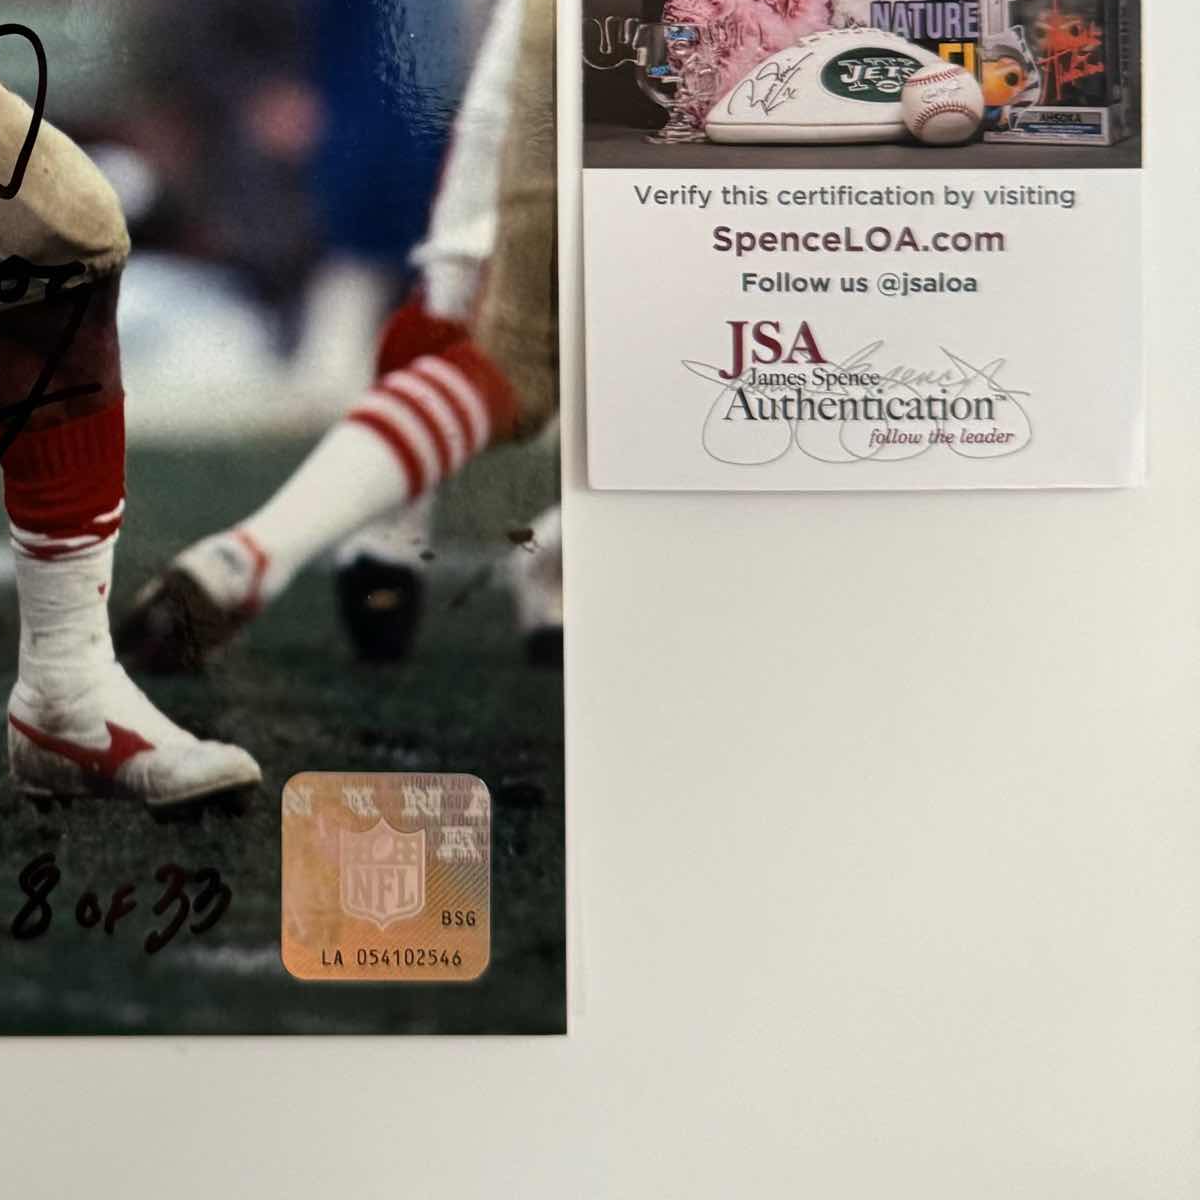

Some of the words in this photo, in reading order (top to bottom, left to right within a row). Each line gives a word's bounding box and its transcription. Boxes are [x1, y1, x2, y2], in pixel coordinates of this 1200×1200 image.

[871, 1, 978, 39] NATURE
[634, 185, 712, 208] Verify
[721, 185, 767, 205] this
[777, 185, 935, 206] certification
[944, 185, 974, 209] by
[983, 186, 1076, 209] visiting
[713, 227, 1005, 256] SpenceLOA.com
[742, 272, 830, 292] Follow
[840, 277, 868, 293] us
[877, 273, 977, 296] @jsaloa
[718, 320, 827, 380] JSA
[749, 368, 807, 386] James
[813, 368, 880, 390] Spence
[869, 429, 922, 448] follow
[928, 429, 955, 444] the
[960, 428, 1014, 444] leader
[353, 866, 415, 914] NFL
[11, 852, 61, 940] 8
[144, 864, 232, 954] 33
[442, 911, 476, 926] BSG
[321, 950, 343, 966] LA
[357, 948, 462, 966] 054102546
